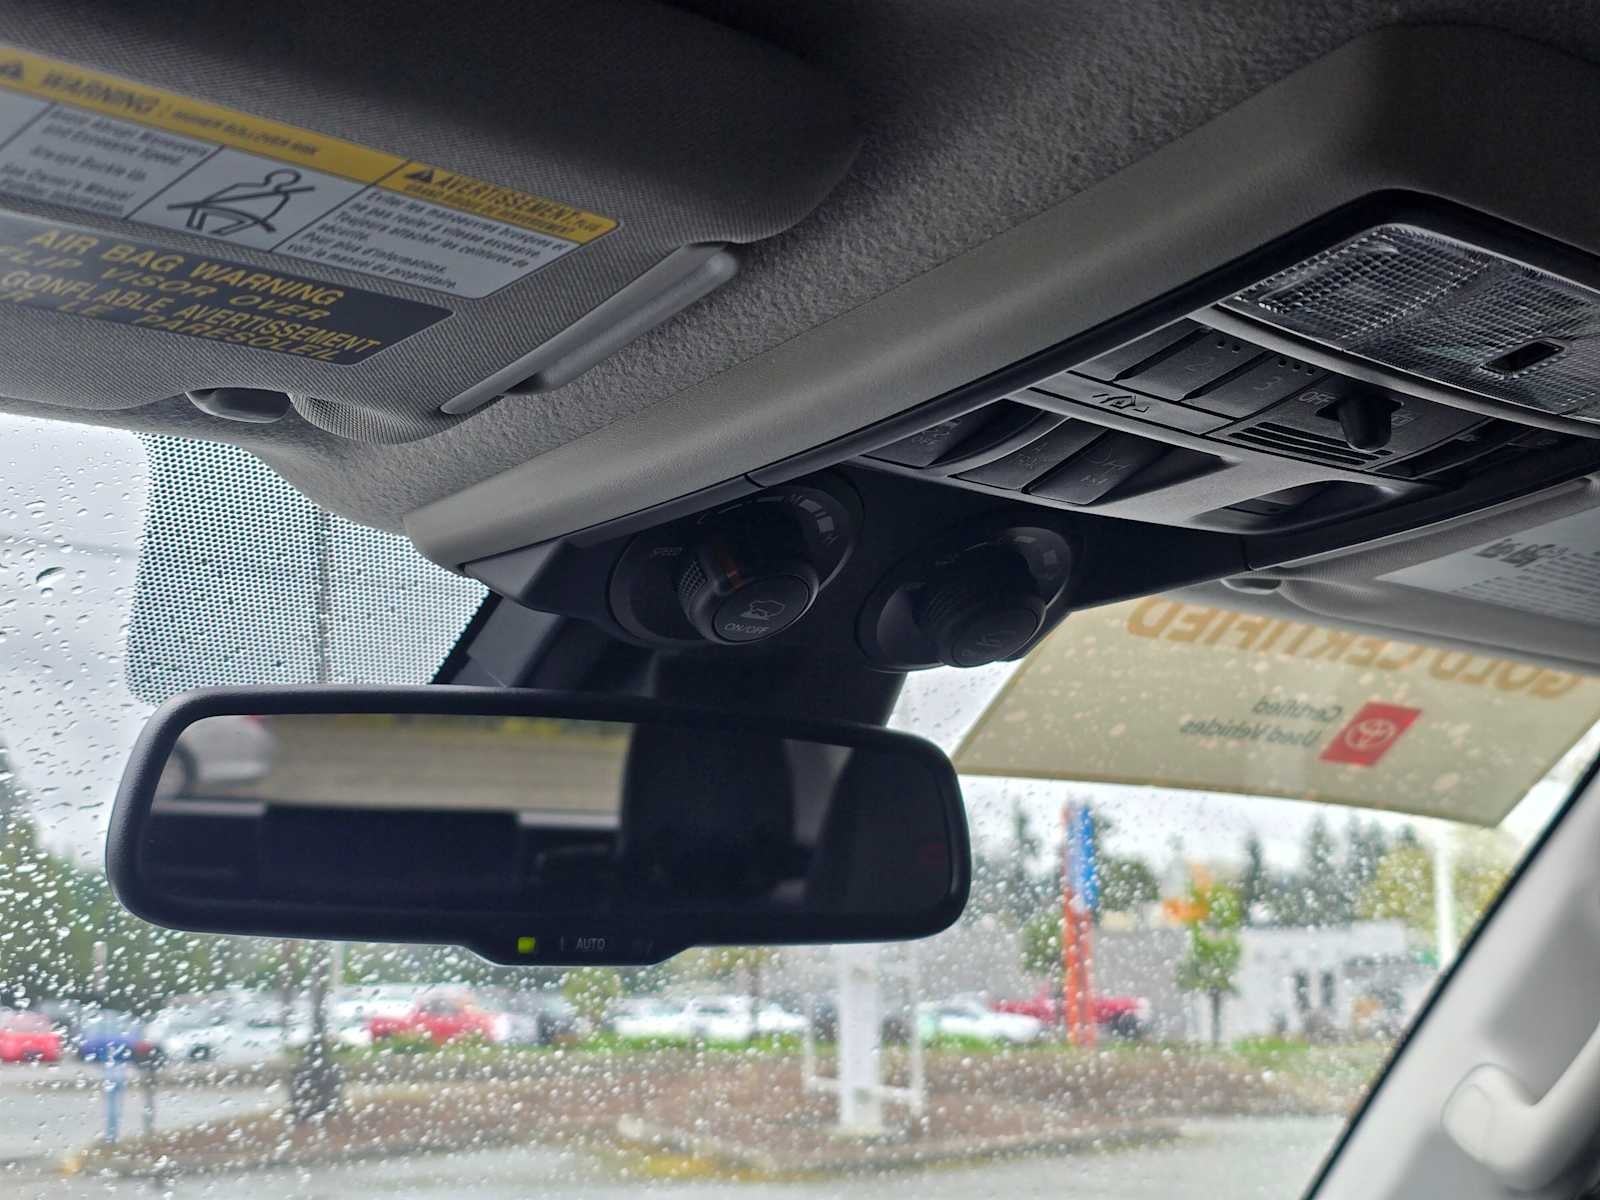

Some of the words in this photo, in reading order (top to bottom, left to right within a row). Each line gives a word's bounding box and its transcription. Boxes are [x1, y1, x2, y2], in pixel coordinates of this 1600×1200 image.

[25, 229, 99, 255] AIR
[102, 244, 184, 273] BAG
[190, 262, 344, 305] WARNING
[2, 270, 175, 317] GONFLABLE
[173, 304, 381, 353] AVERTISSEMENT
[101, 266, 218, 297] VISOR
[229, 294, 331, 321] OVER
[131, 315, 339, 361] PARESOLEIL
[724, 621, 769, 635] ON/OFF
[576, 937, 606, 951] AUTO
